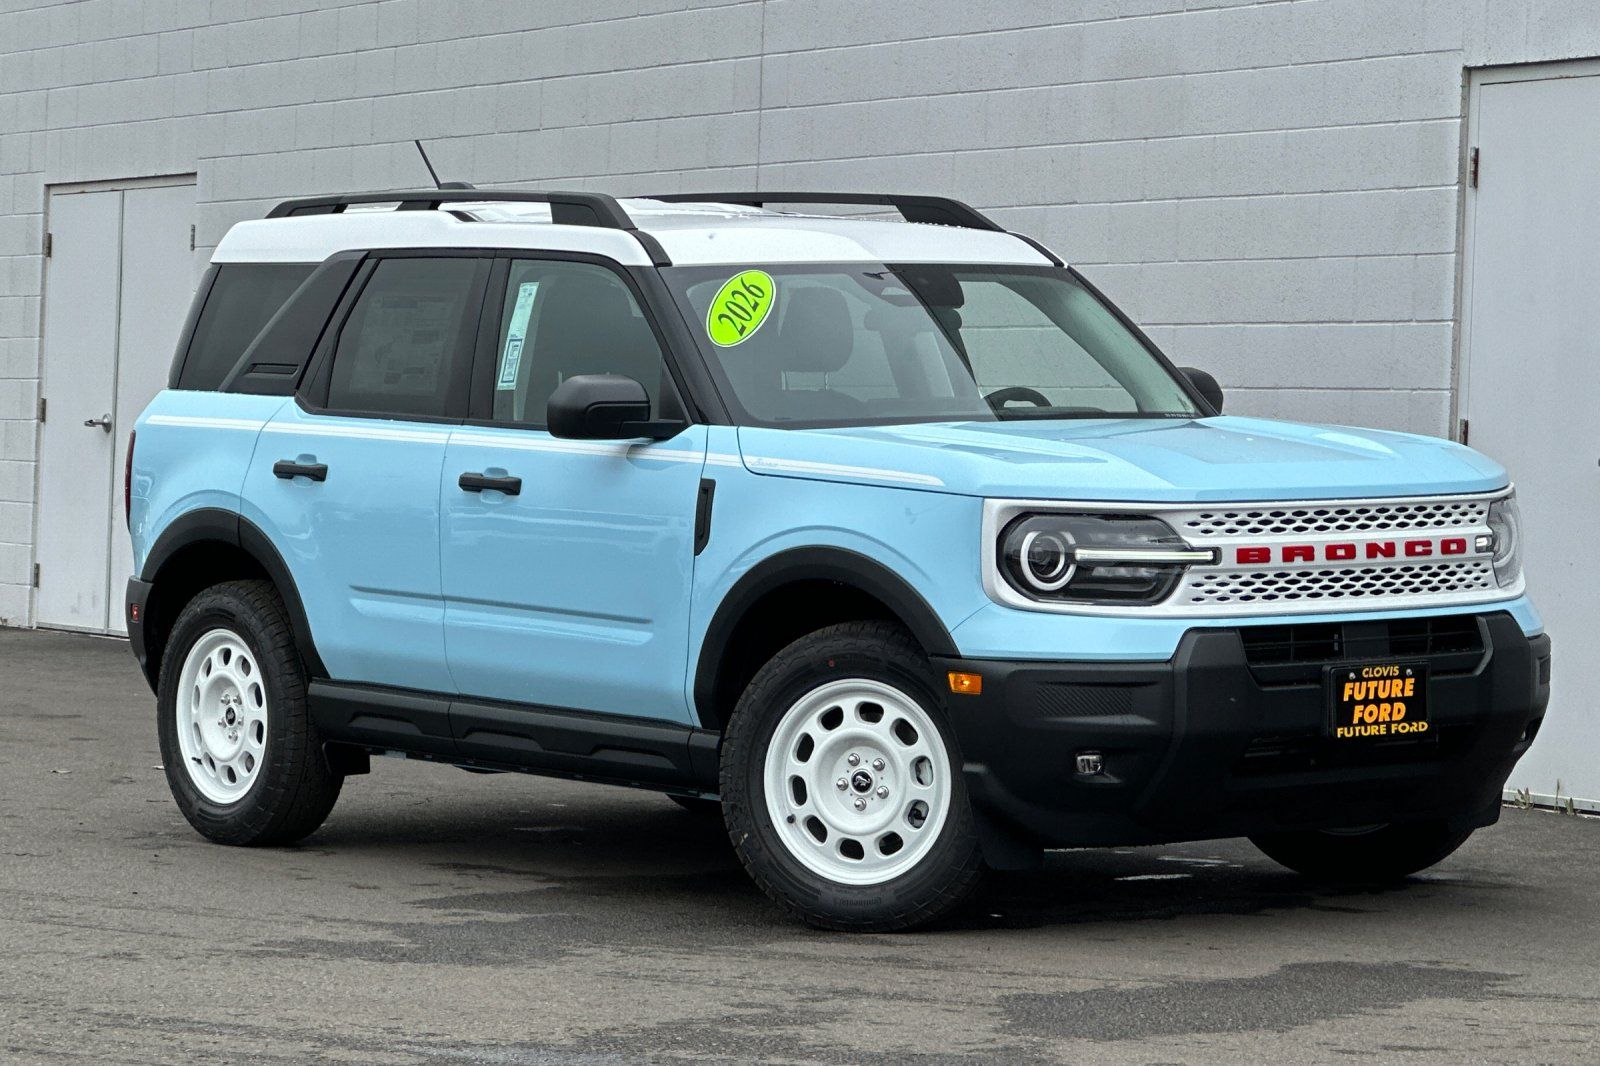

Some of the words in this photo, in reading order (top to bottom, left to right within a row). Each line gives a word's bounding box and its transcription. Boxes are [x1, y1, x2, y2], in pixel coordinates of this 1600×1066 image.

[717, 277, 765, 336] 2026
[1236, 538, 1467, 564] BRONCO
[1362, 666, 1400, 678] CLOVIS
[1343, 678, 1415, 701] FUTURE
[1353, 702, 1406, 724] FORD
[1337, 724, 1387, 738] FUTURE
[1391, 721, 1429, 734] FORD
